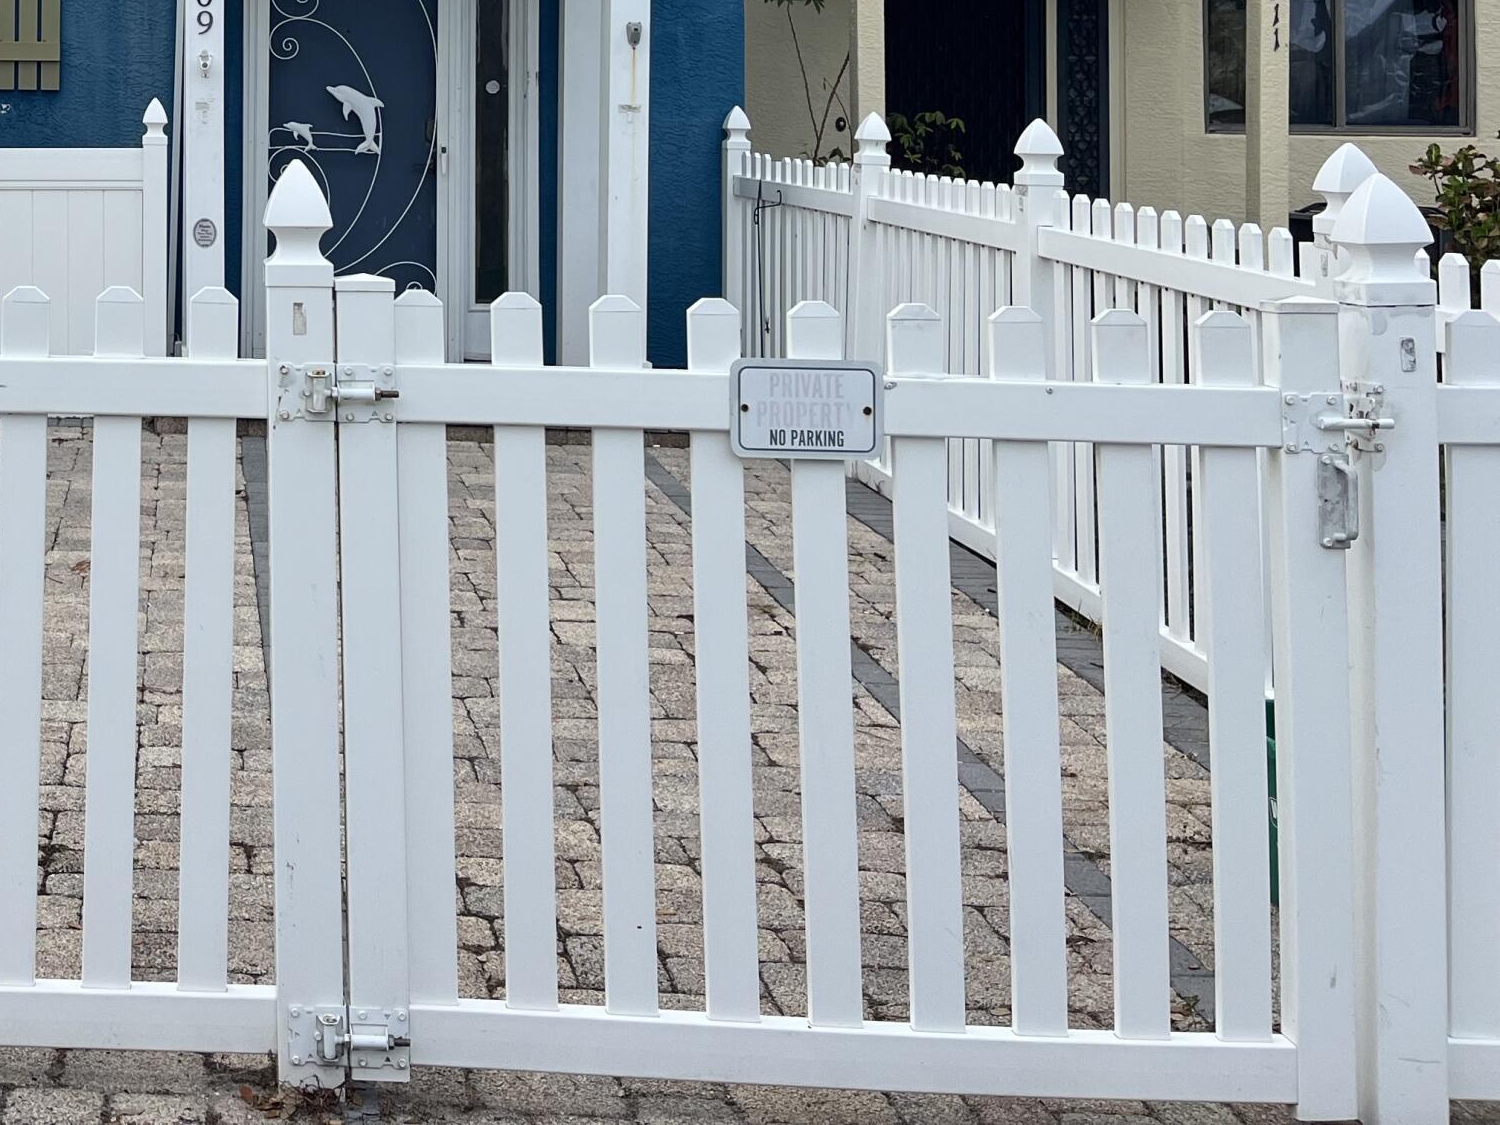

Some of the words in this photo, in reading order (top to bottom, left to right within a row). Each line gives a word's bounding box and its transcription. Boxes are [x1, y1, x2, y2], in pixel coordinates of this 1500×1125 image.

[770, 373, 844, 398] PRIVATE
[757, 402, 856, 427] PROPERTY
[770, 429, 786, 446] NO
[791, 430, 844, 447] PARKING
